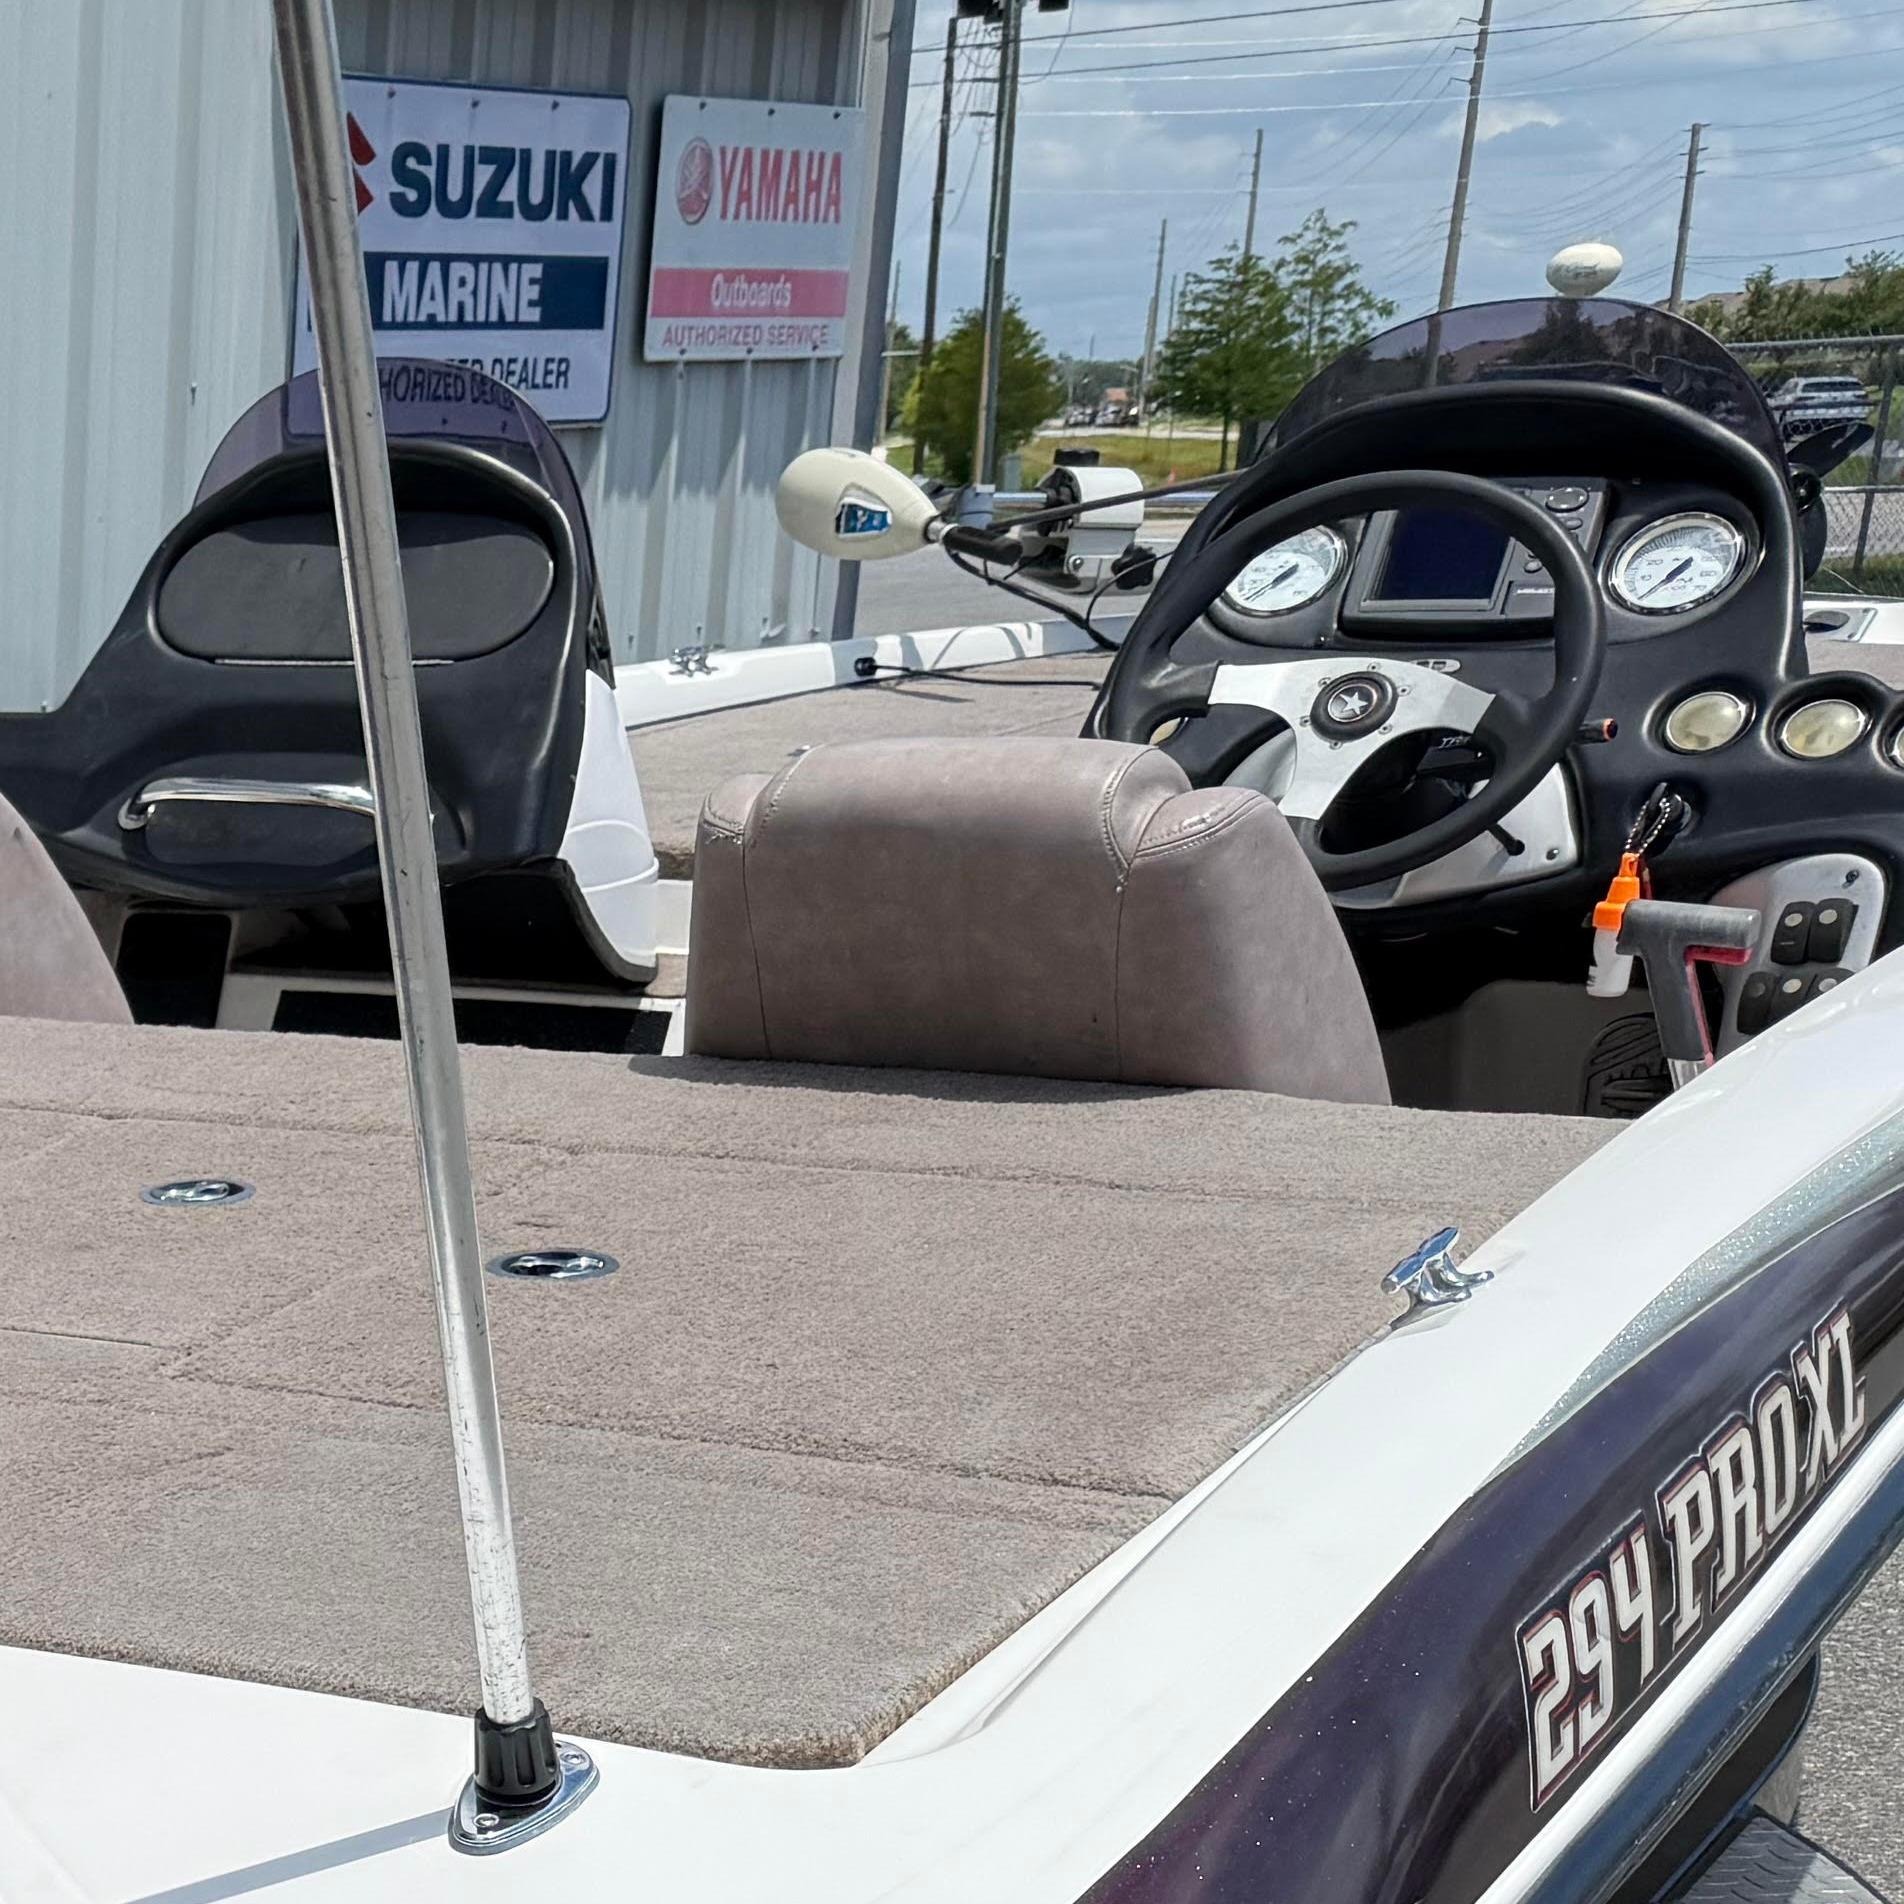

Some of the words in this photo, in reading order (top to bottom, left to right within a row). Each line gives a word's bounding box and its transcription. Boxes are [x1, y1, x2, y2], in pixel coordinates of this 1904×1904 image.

[389, 140, 617, 223] SUZUKI
[718, 145, 843, 224] YAMAHA
[381, 260, 542, 323] MARINE
[711, 272, 792, 308] Outboards
[662, 324, 763, 347] AUTHORIZED
[767, 324, 830, 345] SERVICE
[1521, 1522, 1655, 1806] 294
